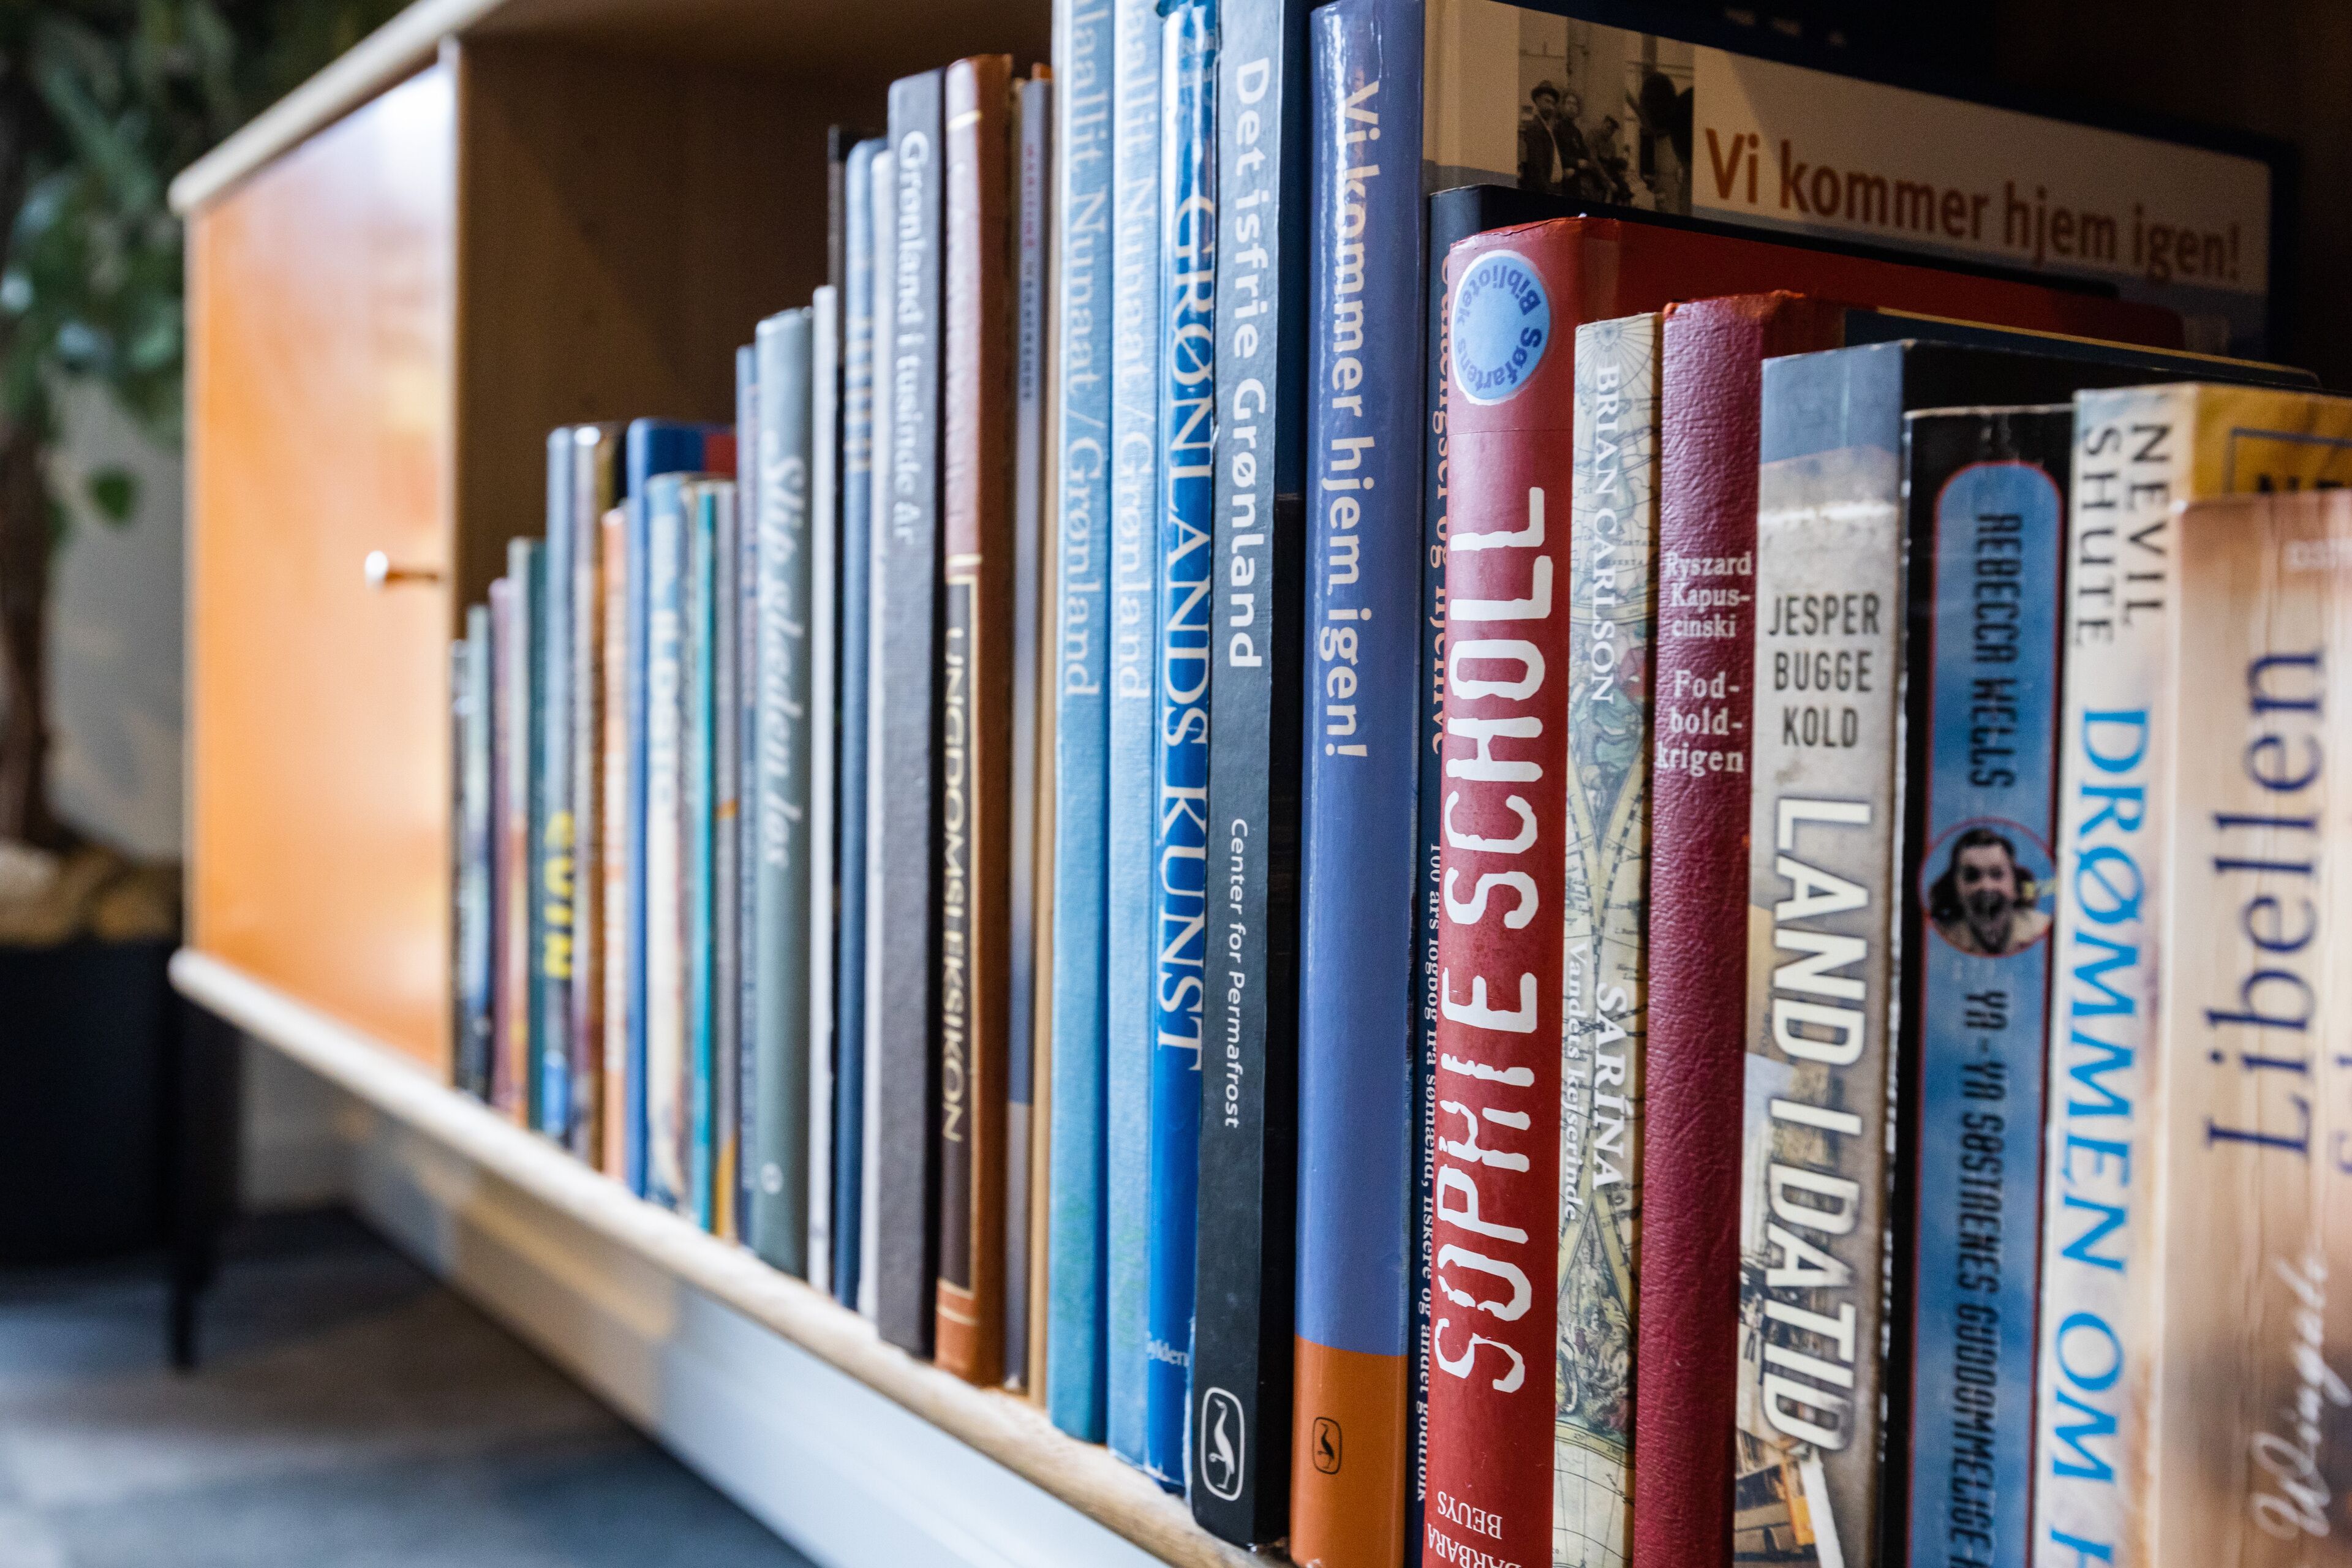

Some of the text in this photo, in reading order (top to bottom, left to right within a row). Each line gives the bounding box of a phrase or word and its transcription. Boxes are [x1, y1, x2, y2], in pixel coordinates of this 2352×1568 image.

[1071, 0, 1109, 173] laallit
[1068, 187, 1106, 390] Nunaat
[1120, 173, 1156, 382] Nunaat
[1457, 263, 1542, 325] Bibliotek
[1705, 128, 2241, 284] Vi kommer hjem igen!
[1230, 56, 1270, 668] Det isfrie Grønland
[1319, 80, 1381, 758] Vi kommer hjem igen!
[1457, 326, 1542, 392] Søfartens
[1065, 437, 1101, 696] Grønland
[1118, 432, 1155, 699] Grønland
[1590, 367, 1621, 705] BRIAN CARLSON
[1664, 551, 1753, 580] Ryszard
[1669, 581, 1752, 611] Kapus-
[1768, 592, 1882, 637] JESPER
[2075, 426, 2122, 647] SHUTE
[2121, 423, 2173, 628] NEVIL
[1156, 195, 1215, 1071] GRØNLANDS KUNST
[1669, 707, 1743, 736] bold-
[1673, 669, 1740, 699] Fod-
[1774, 649, 1874, 693] BUGGE
[1782, 706, 1860, 748] KOLD
[1967, 512, 2024, 790] REBECCA WELLS
[1654, 742, 1745, 778] krigen
[1223, 818, 1250, 1128] Center for Permafrost
[1434, 486, 1553, 1393] SOPHIE SCHOLL
[2060, 707, 2150, 1275] DRØMMEN
[2202, 643, 2325, 1154] Libellen
[1562, 942, 1589, 1220] Vandets kejserinde
[1762, 797, 1871, 1452] LAND I DATID
[2050, 1311, 2125, 1486] OM
[1436, 1490, 1504, 1540] BEUYS
